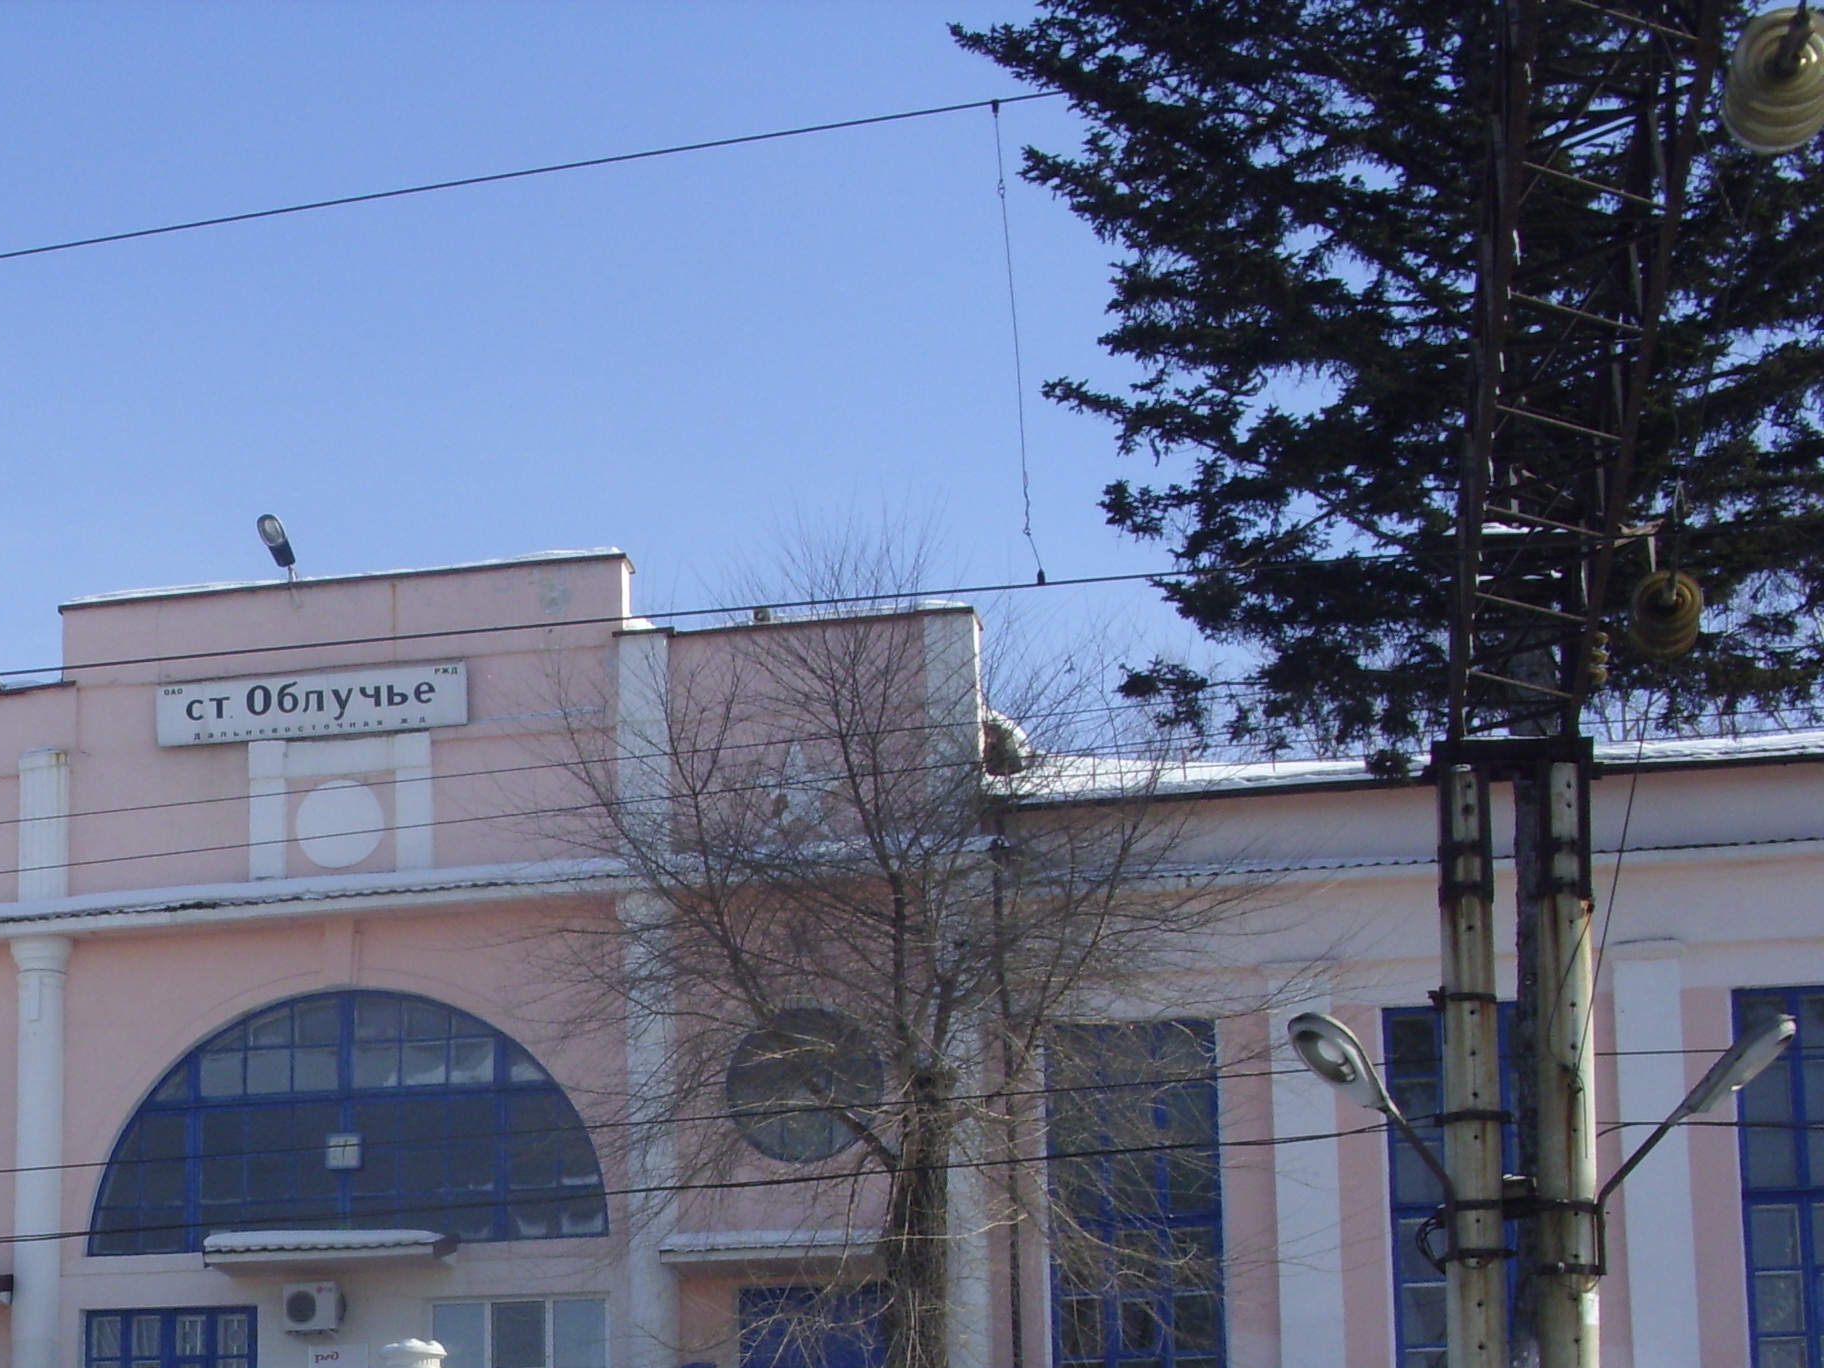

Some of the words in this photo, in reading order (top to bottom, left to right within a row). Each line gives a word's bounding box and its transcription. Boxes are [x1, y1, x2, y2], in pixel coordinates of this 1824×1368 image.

[434, 666, 458, 675] РЖД
[164, 687, 183, 696] ОАО
[245, 680, 436, 721] Облучье
